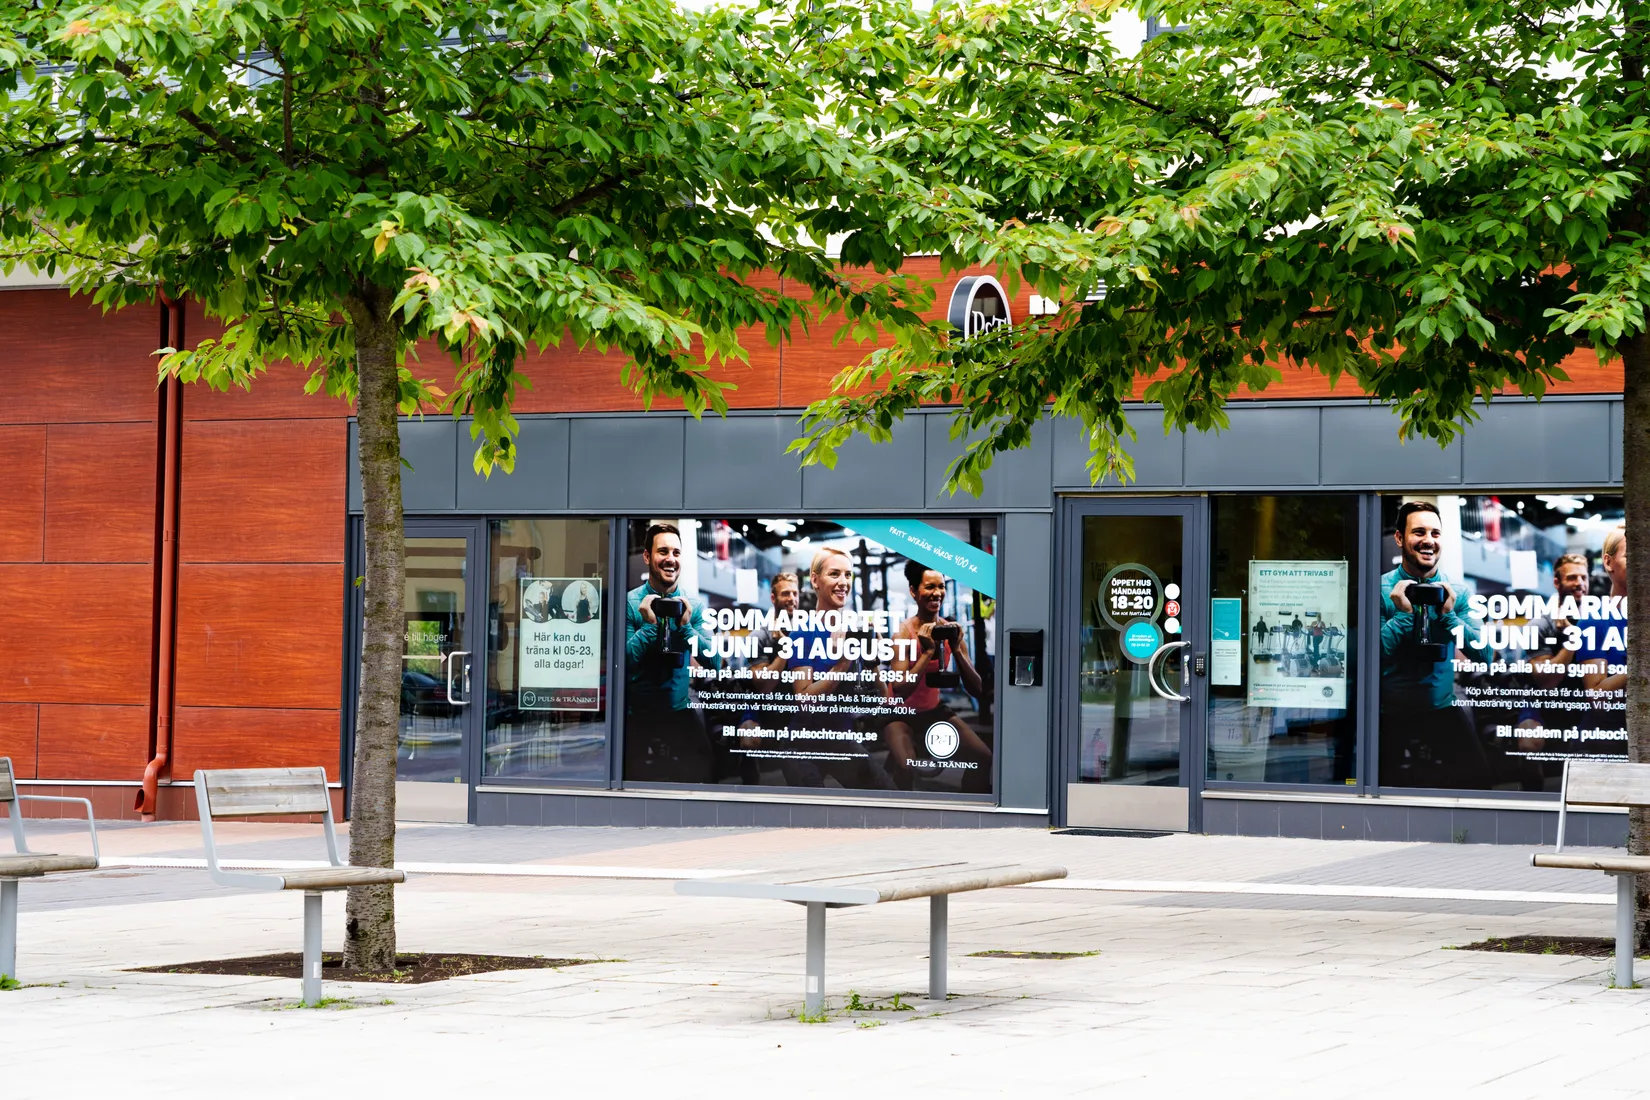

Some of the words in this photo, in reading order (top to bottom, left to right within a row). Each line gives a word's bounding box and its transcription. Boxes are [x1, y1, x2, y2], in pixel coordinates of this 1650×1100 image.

[889, 526, 907, 538] FRITT
[908, 536, 932, 551] INTRÄDE
[934, 546, 954, 560] VÄRDE
[955, 554, 969, 568] 400
[1112, 578, 1135, 586] ÖPPET
[1112, 587, 1152, 595] MÅNDAGAR
[1110, 596, 1154, 609] 18-20
[702, 608, 904, 633] SOMMARKORTET
[412, 632, 421, 641] till
[423, 632, 448, 643] höger
[534, 632, 550, 642] Här
[553, 632, 571, 642] kan
[573, 632, 586, 642] du
[1451, 625, 1464, 649] 1
[1470, 626, 1538, 650] JUNI
[1562, 626, 1596, 651] 31
[1602, 626, 1627, 651] A
[526, 646, 550, 655] träna
[553, 646, 561, 655] kl
[564, 646, 594, 656] 05-23,
[687, 636, 698, 658] 1
[702, 636, 758, 659] JUNI
[778, 636, 804, 660] 31
[808, 638, 917, 662] AUGUSTI
[534, 659, 550, 668] alla
[553, 659, 584, 671] dagar!
[1451, 659, 1488, 673] Träna
[1490, 658, 1507, 676] på
[1510, 660, 1533, 673] alla
[1535, 660, 1565, 674] våra
[1568, 663, 1598, 678] gym
[1601, 661, 1605, 674] i
[687, 666, 716, 678] Träna
[719, 666, 732, 681] på
[734, 667, 752, 679] alla
[755, 667, 779, 679] våra
[781, 670, 805, 683] gym
[807, 669, 810, 680] i
[813, 671, 858, 681] sommar
[860, 670, 877, 682] för
[879, 670, 903, 683] 895
[906, 670, 918, 683] kr
[698, 691, 711, 700] Köp
[712, 690, 725, 699] vårt
[726, 692, 764, 700] sommarkort
[766, 692, 773, 700] så
[775, 692, 784, 700] får
[795, 693, 817, 703] tillgång
[860, 694, 887, 704] Tränings
[1466, 687, 1481, 697] Köp
[1482, 686, 1498, 696] vårt
[1500, 688, 1547, 696] sommarkort
[1549, 688, 1559, 696] så
[1560, 688, 1572, 697] får
[1573, 688, 1584, 697] du
[1585, 688, 1613, 700] tillgång
[1614, 689, 1623, 698] till
[687, 701, 736, 712] utomhusträning
[750, 702, 761, 710] vår
[762, 703, 800, 713] träningsapp.
[809, 704, 828, 713] bjuder
[829, 705, 838, 714] på
[839, 705, 891, 715] inträdesavgiften
[892, 706, 907, 715] 400
[1452, 699, 1512, 710] utomhusträning
[1514, 700, 1528, 708] och
[1530, 699, 1543, 708] vår
[1545, 700, 1592, 711] träningsapp.
[1593, 701, 1602, 709] Vi
[722, 726, 735, 737] Bli
[737, 727, 775, 738] medlem
[777, 727, 789, 741] på
[791, 728, 877, 743] pulsochtraning.se
[1496, 725, 1512, 737] Bli
[1514, 726, 1561, 739] medlem
[1564, 726, 1579, 742] på
[906, 759, 928, 767] PULS
[937, 761, 978, 769] TRÄNING
